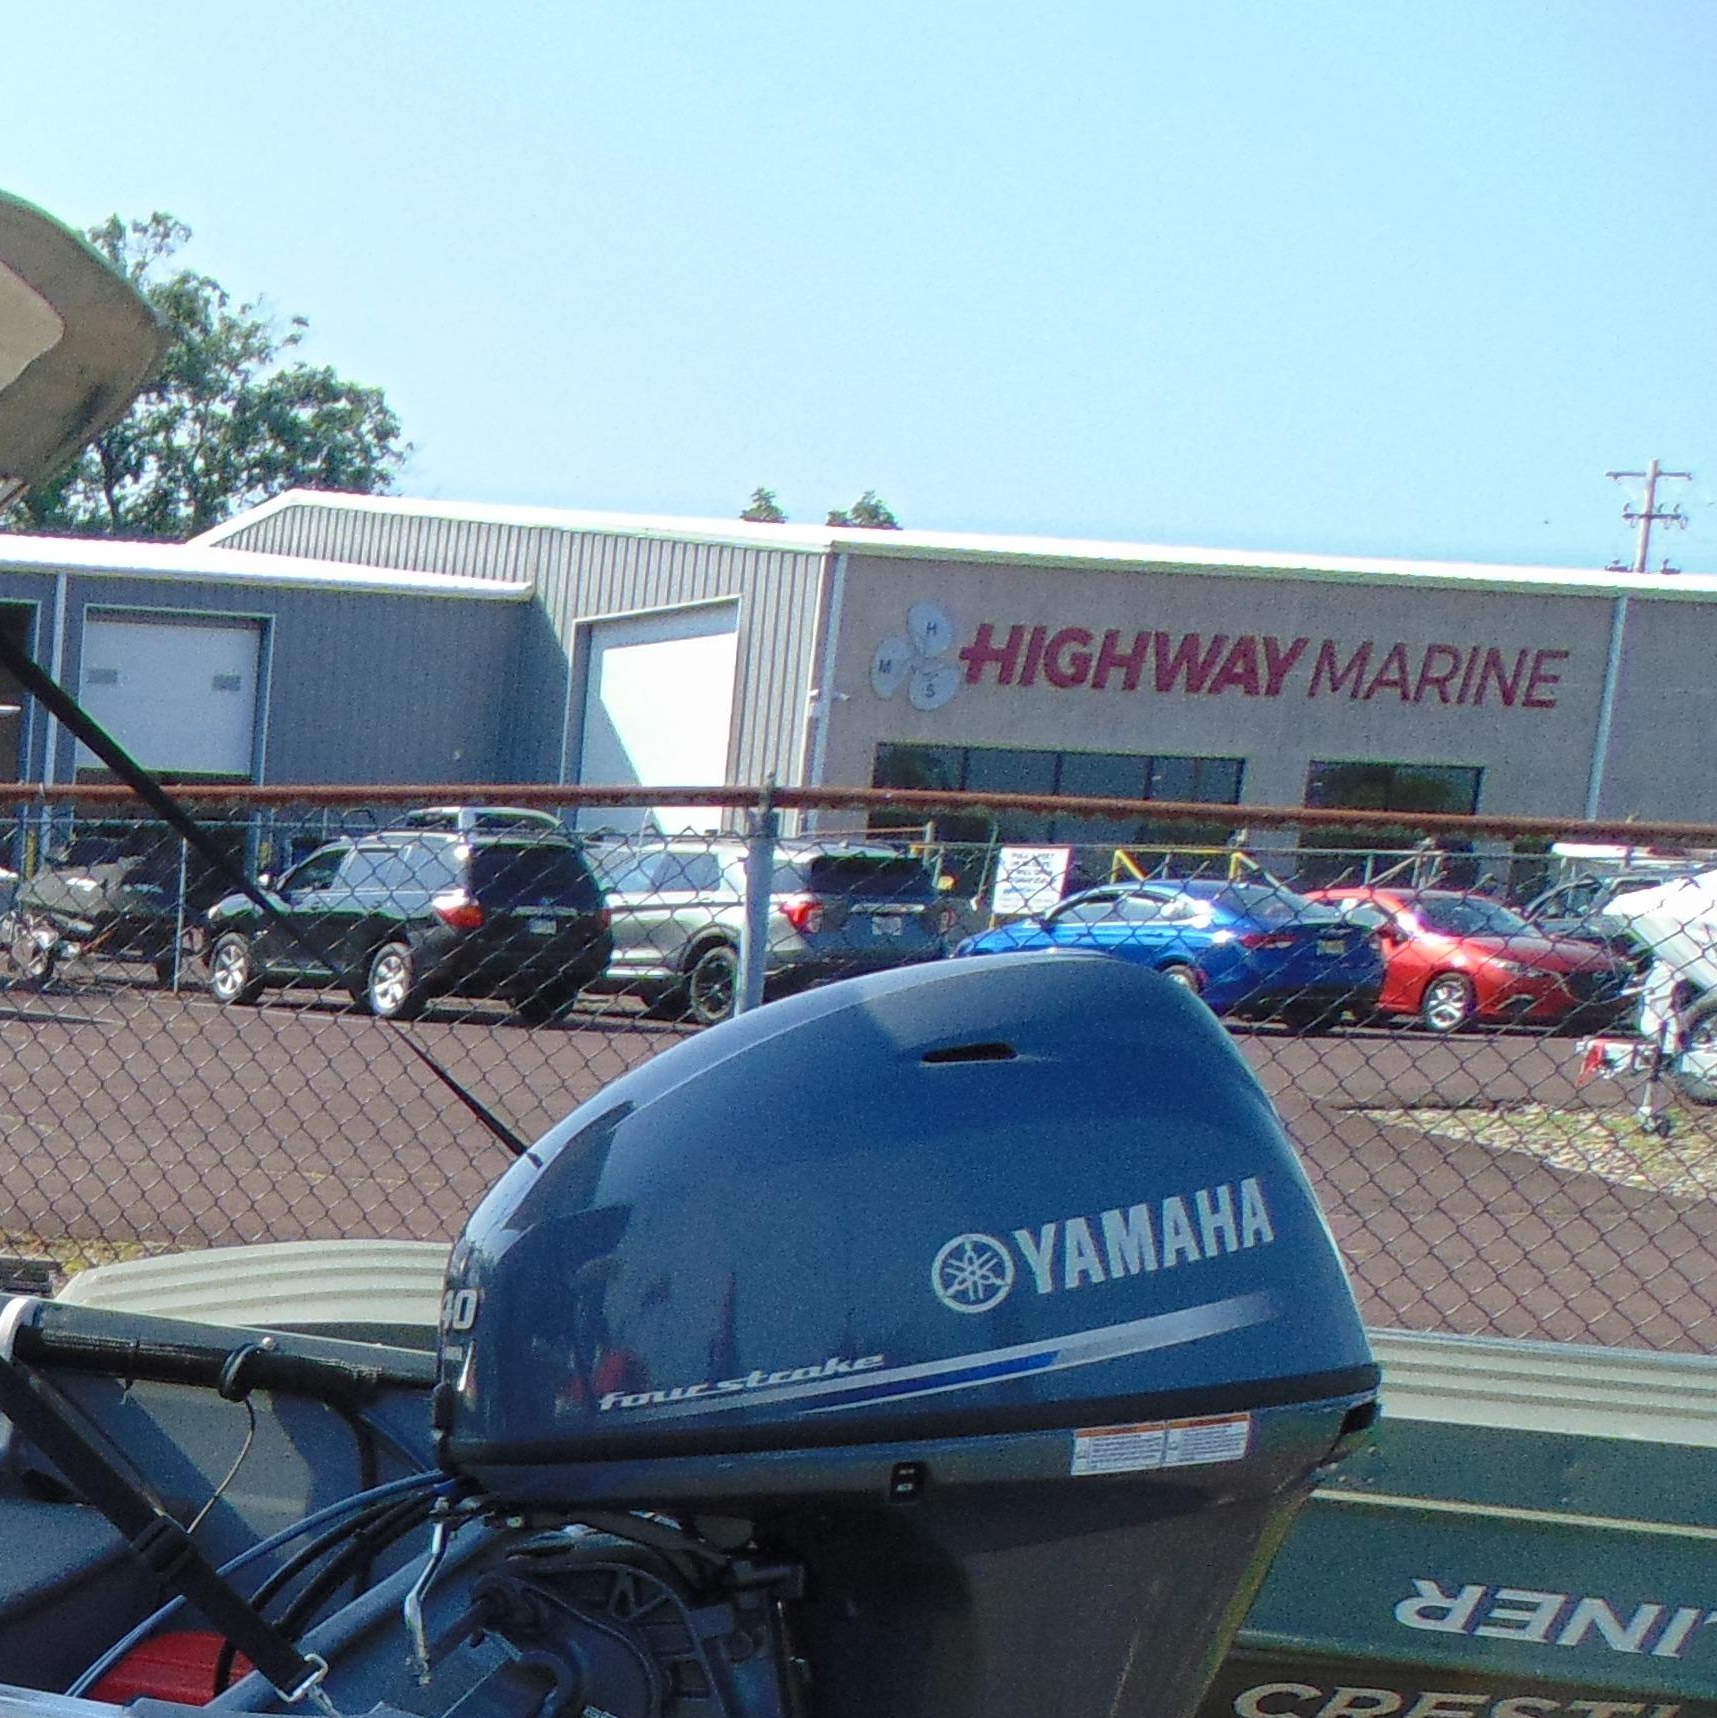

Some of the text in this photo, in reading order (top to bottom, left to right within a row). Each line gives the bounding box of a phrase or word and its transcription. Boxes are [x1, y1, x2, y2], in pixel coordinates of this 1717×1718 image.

[958, 622, 1569, 709] HIGHWAY MARINE
[1013, 1177, 1275, 1295] YAMAHA
[1393, 1577, 1717, 1659] INER
